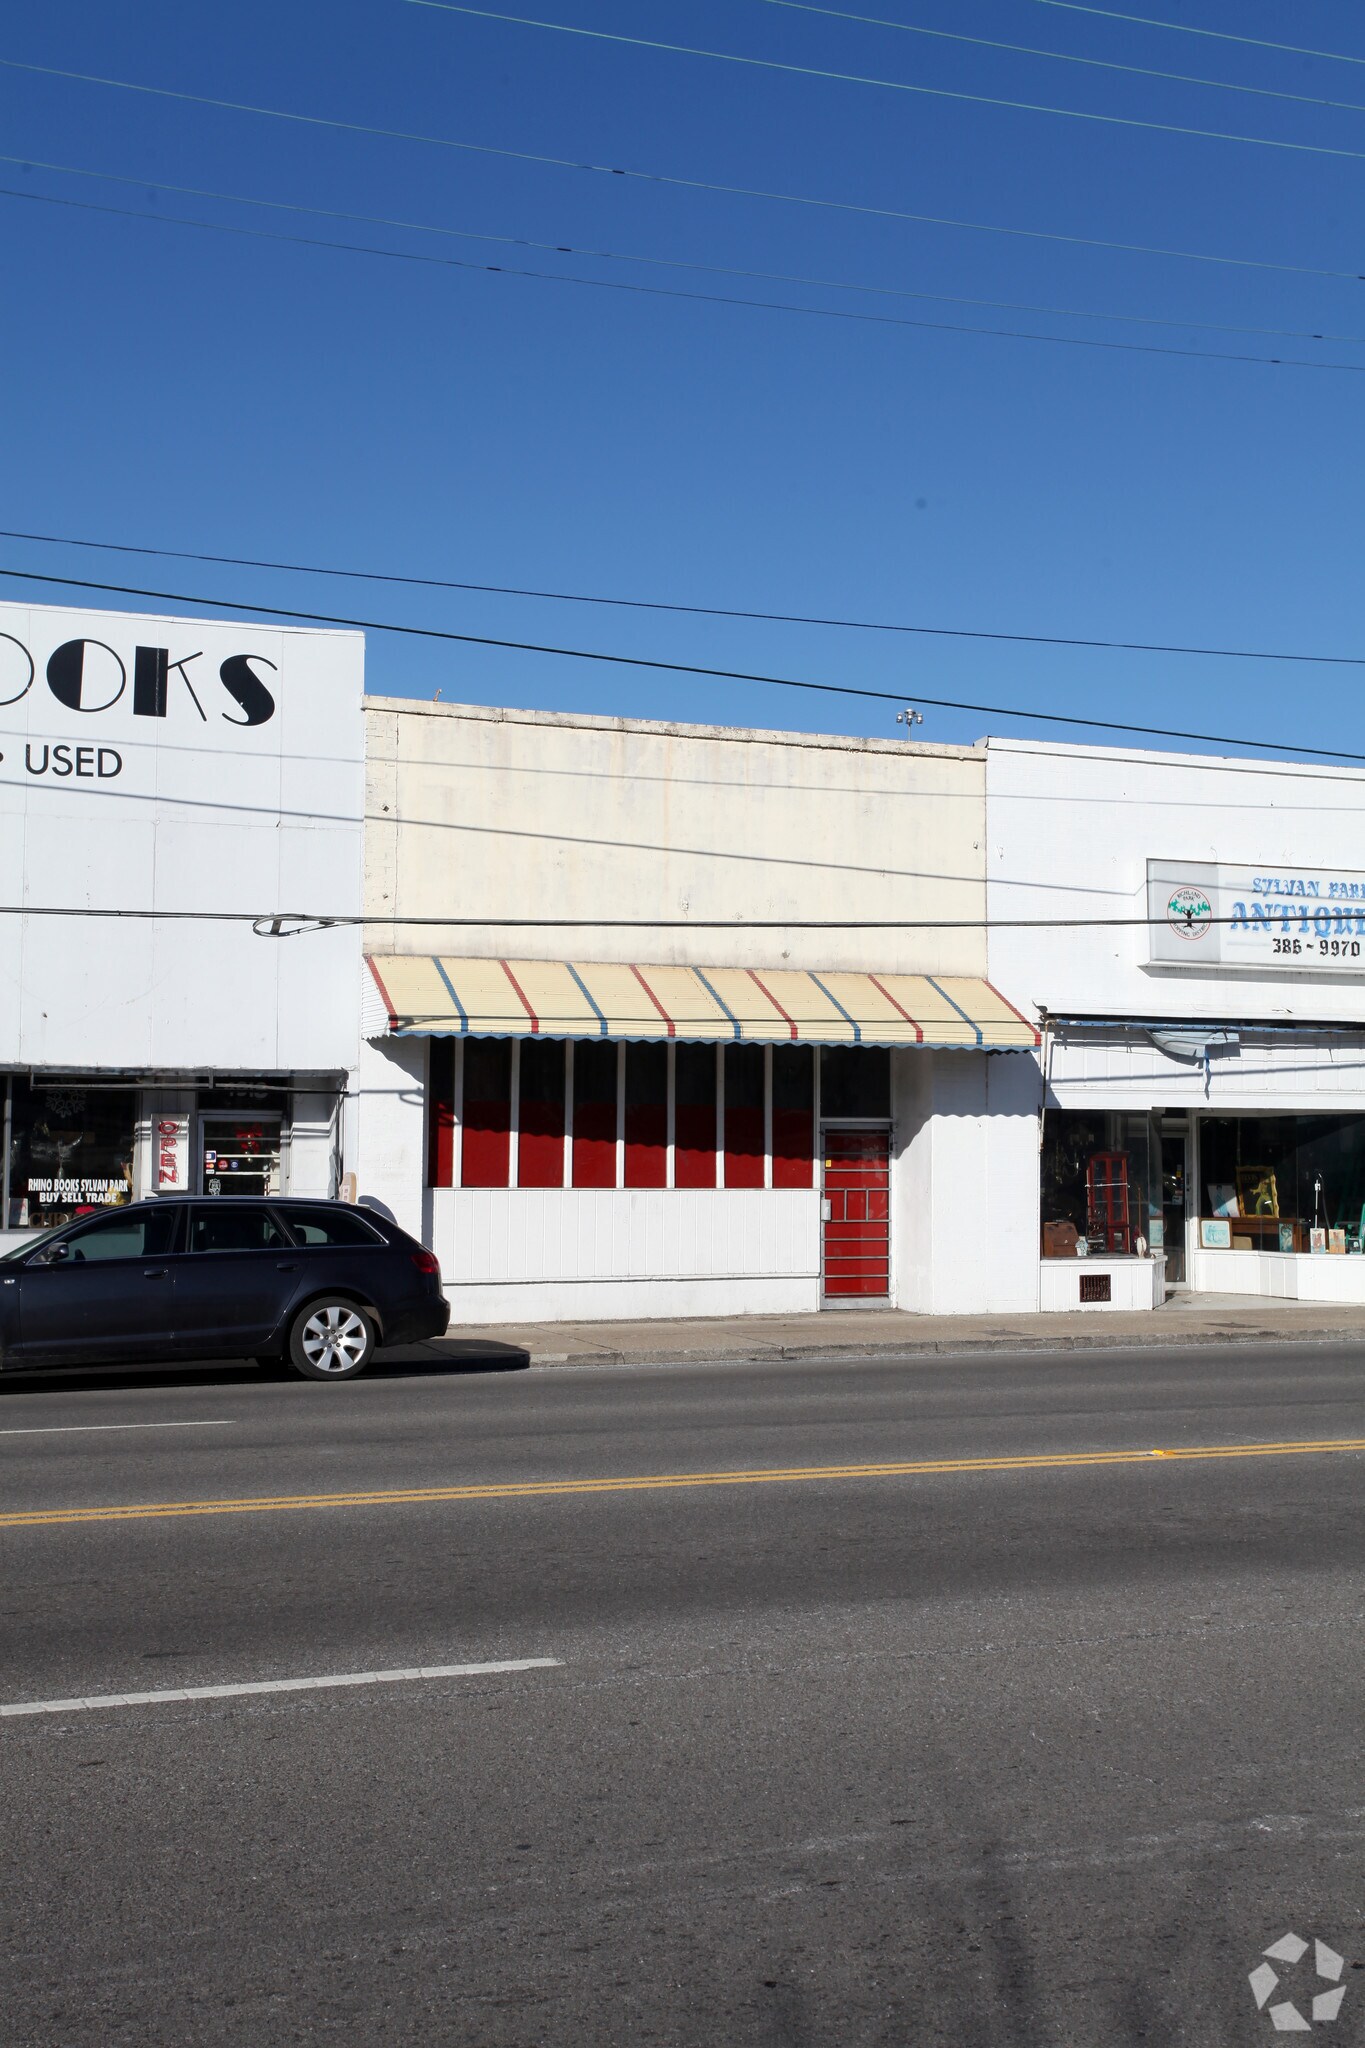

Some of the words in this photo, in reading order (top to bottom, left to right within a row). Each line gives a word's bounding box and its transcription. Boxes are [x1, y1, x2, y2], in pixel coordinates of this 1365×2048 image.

[25, 743, 123, 778] USED
[1252, 877, 1320, 897] SYLVAN
[158, 1121, 180, 1184] OPEN
[28, 1178, 52, 1192] RHINO
[54, 1178, 79, 1192] BOOKS
[80, 1179, 108, 1192] SYLVAN
[109, 1179, 128, 1192] PARK
[39, 1192, 59, 1203] BUY
[61, 1192, 83, 1203] SELL
[86, 1192, 117, 1203] TRADE
